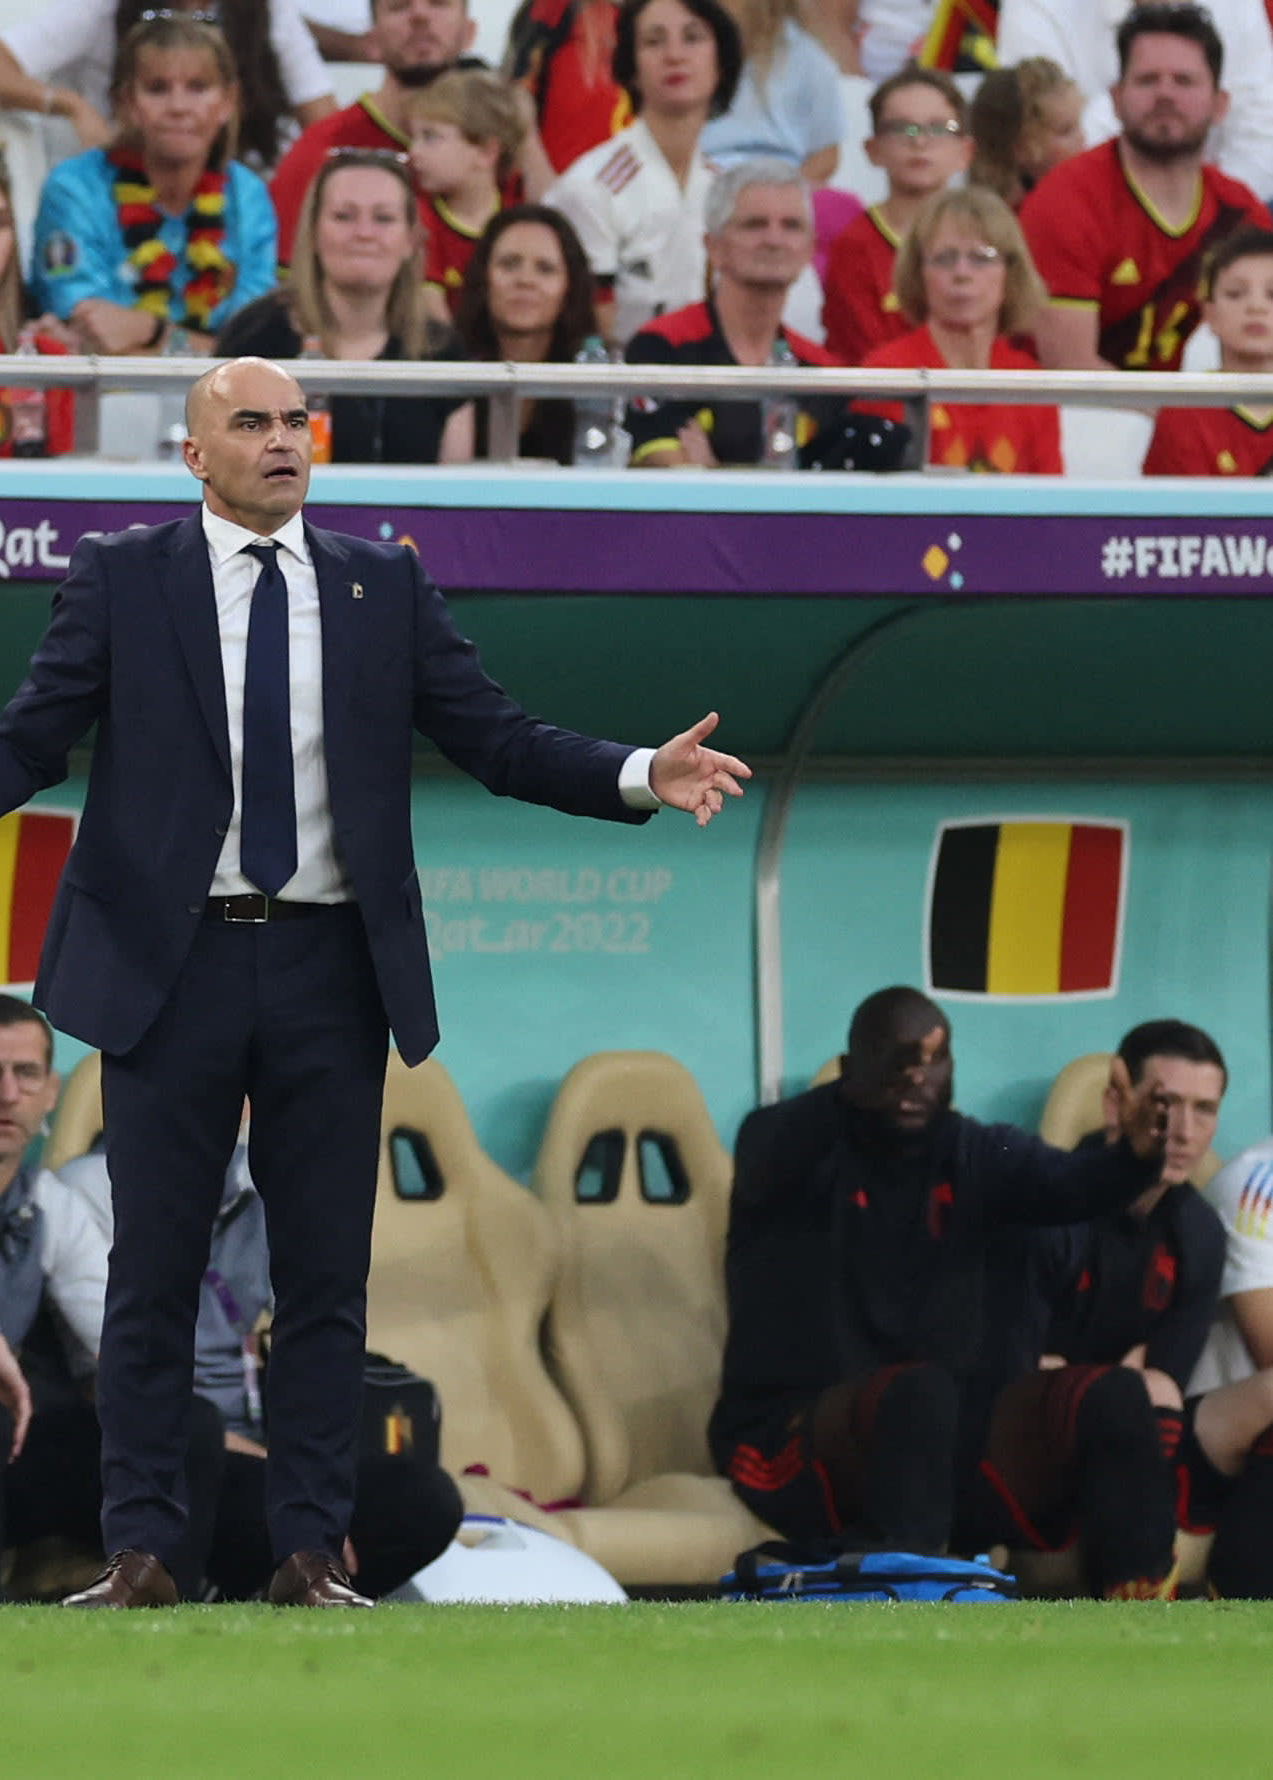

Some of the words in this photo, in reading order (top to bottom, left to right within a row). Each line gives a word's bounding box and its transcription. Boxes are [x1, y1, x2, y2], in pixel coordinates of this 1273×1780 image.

[1101, 535, 1273, 578] #FIFAW
[419, 868, 473, 902] IFA
[479, 868, 601, 902] WORLD
[606, 868, 673, 903] CUP
